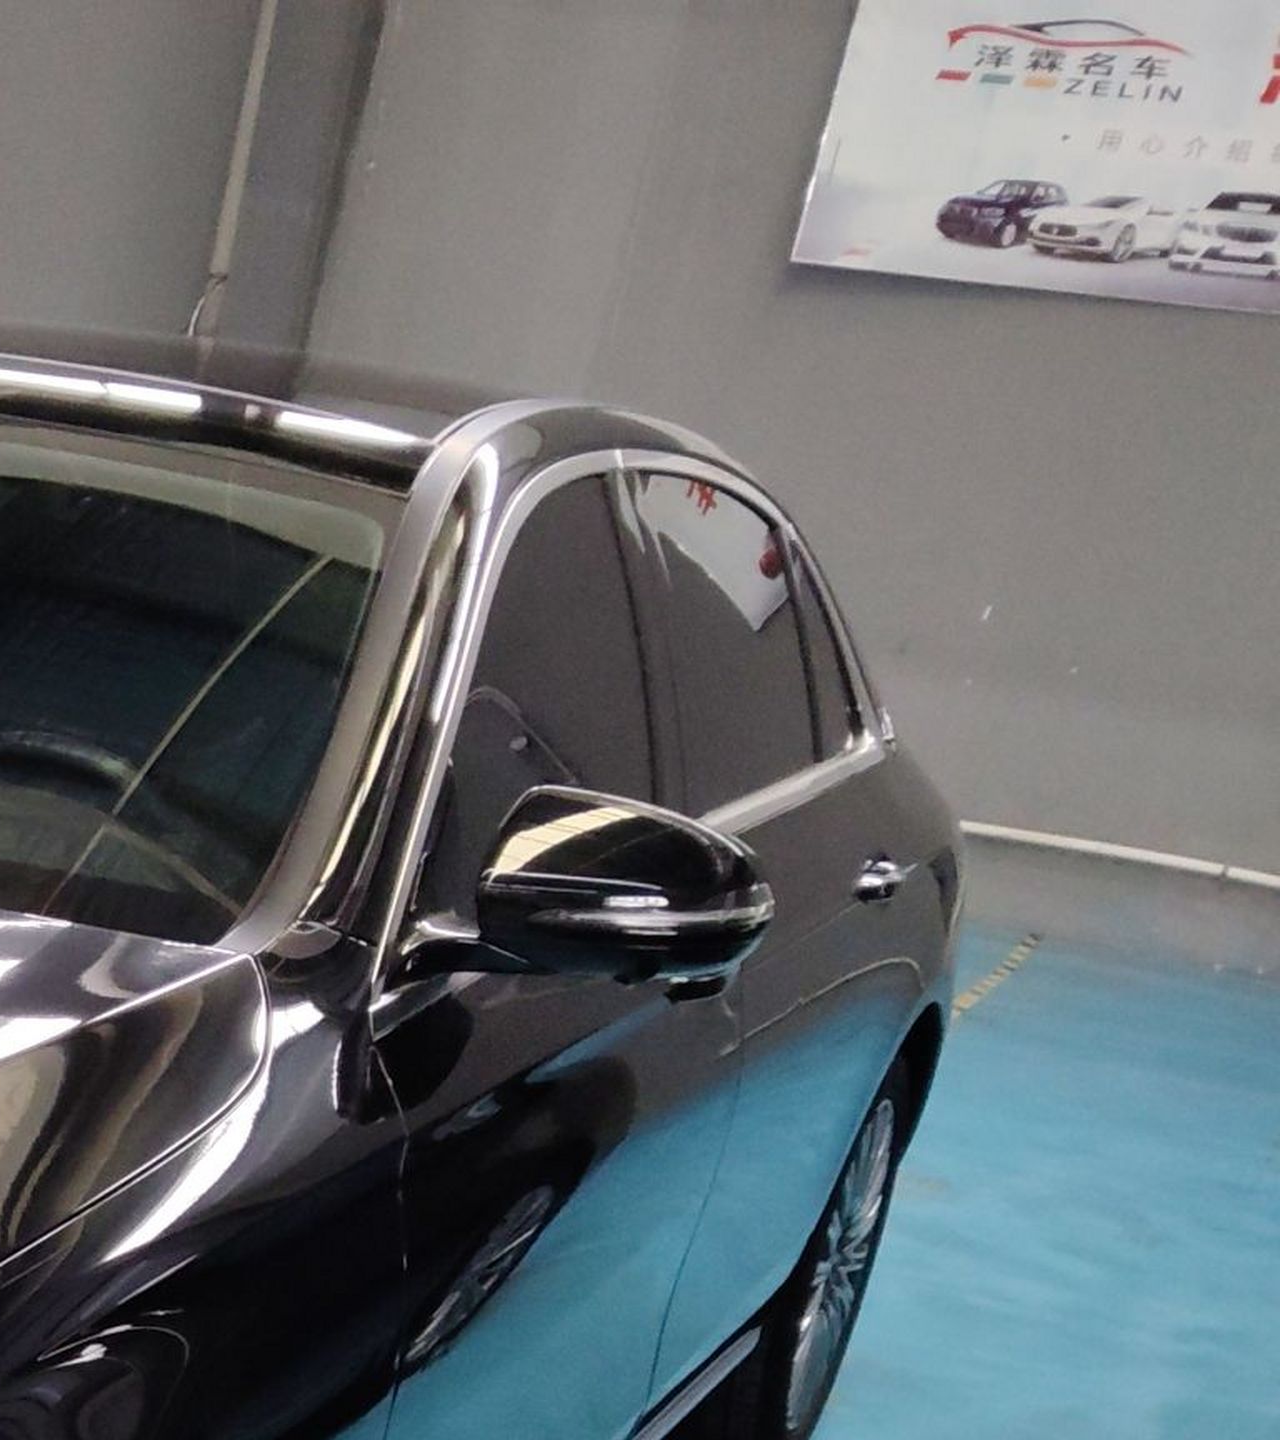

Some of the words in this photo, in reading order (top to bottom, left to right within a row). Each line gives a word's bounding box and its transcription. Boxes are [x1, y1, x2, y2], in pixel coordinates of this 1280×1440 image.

[973, 44, 1171, 80] 泽霖名车
[1063, 78, 1183, 102] ZELIN
